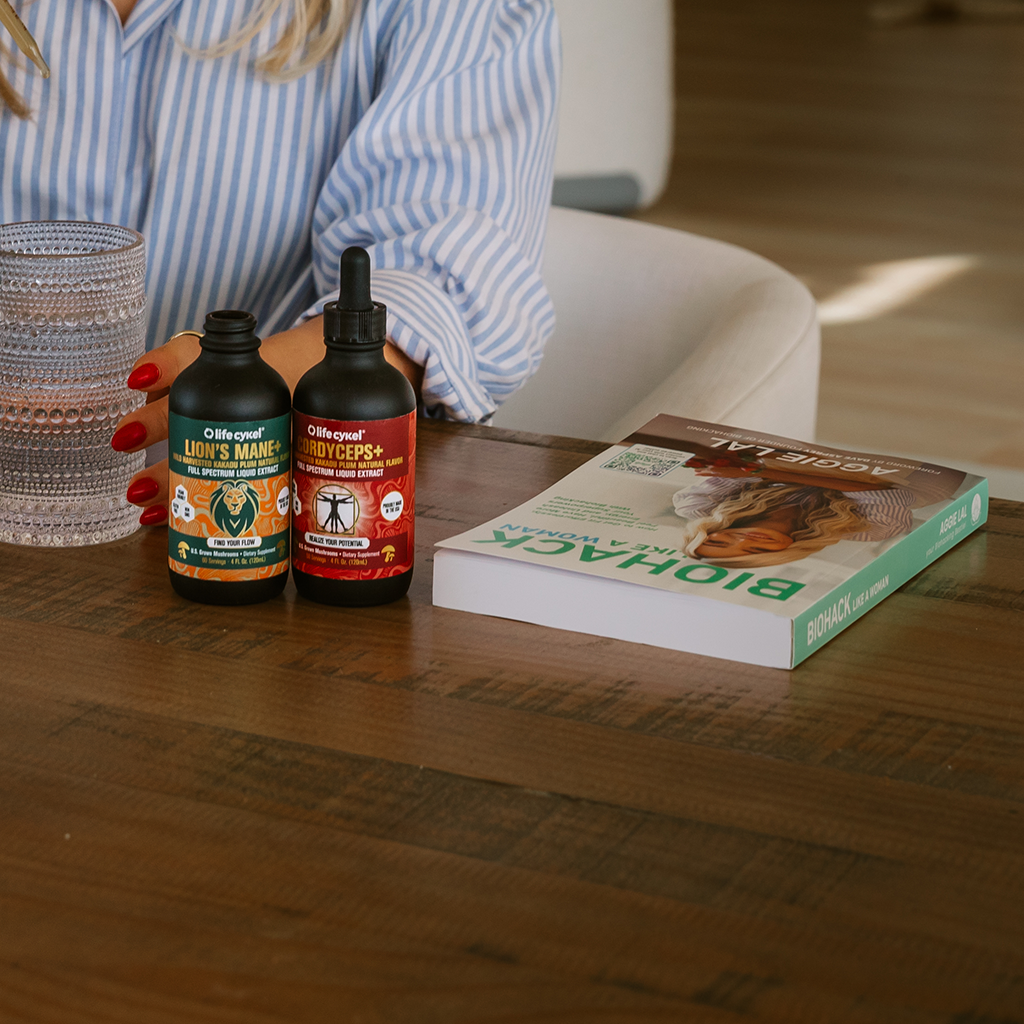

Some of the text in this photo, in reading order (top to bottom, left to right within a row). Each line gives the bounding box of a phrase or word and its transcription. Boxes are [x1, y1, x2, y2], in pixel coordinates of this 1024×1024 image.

[686, 425, 742, 438] BIOHACKING
[185, 439, 229, 460] LION'S
[234, 440, 281, 460] MANE+
[297, 435, 383, 461] CORDYCEPS+
[710, 437, 775, 456] LAL
[756, 439, 802, 451] FOUNDER
[803, 448, 843, 458] ASPREY
[182, 456, 212, 467] HARVESTED
[213, 460, 238, 469] KAKADU
[239, 460, 257, 469] PLUM
[297, 461, 384, 478] FULL SPECTRUM LIQUID EXTRACT
[315, 458, 337, 468] KAKADU
[339, 460, 356, 469] PLUM
[358, 460, 384, 469] NATURAL
[386, 456, 403, 467] FLAVOR
[776, 452, 900, 475] AGGIE
[886, 461, 941, 475] FOREWORD
[187, 464, 279, 477] FULL SPECTRUM LIQUID EXTRACT
[939, 505, 967, 536] AGGIE LAL
[499, 524, 600, 544] WOMAN
[241, 538, 256, 546] FLOW
[326, 538, 337, 546] YOUR
[339, 539, 363, 547] POTENTIAL
[199, 548, 212, 556] Grown
[304, 544, 314, 553] Grown
[315, 547, 338, 557] Mushrooms
[342, 550, 356, 558] Dietary
[357, 550, 380, 558] Supplement
[208, 557, 226, 565] Servings
[470, 529, 807, 602] BIOHACK
[807, 574, 889, 646] BIOHACK LIKE A WOMAN
